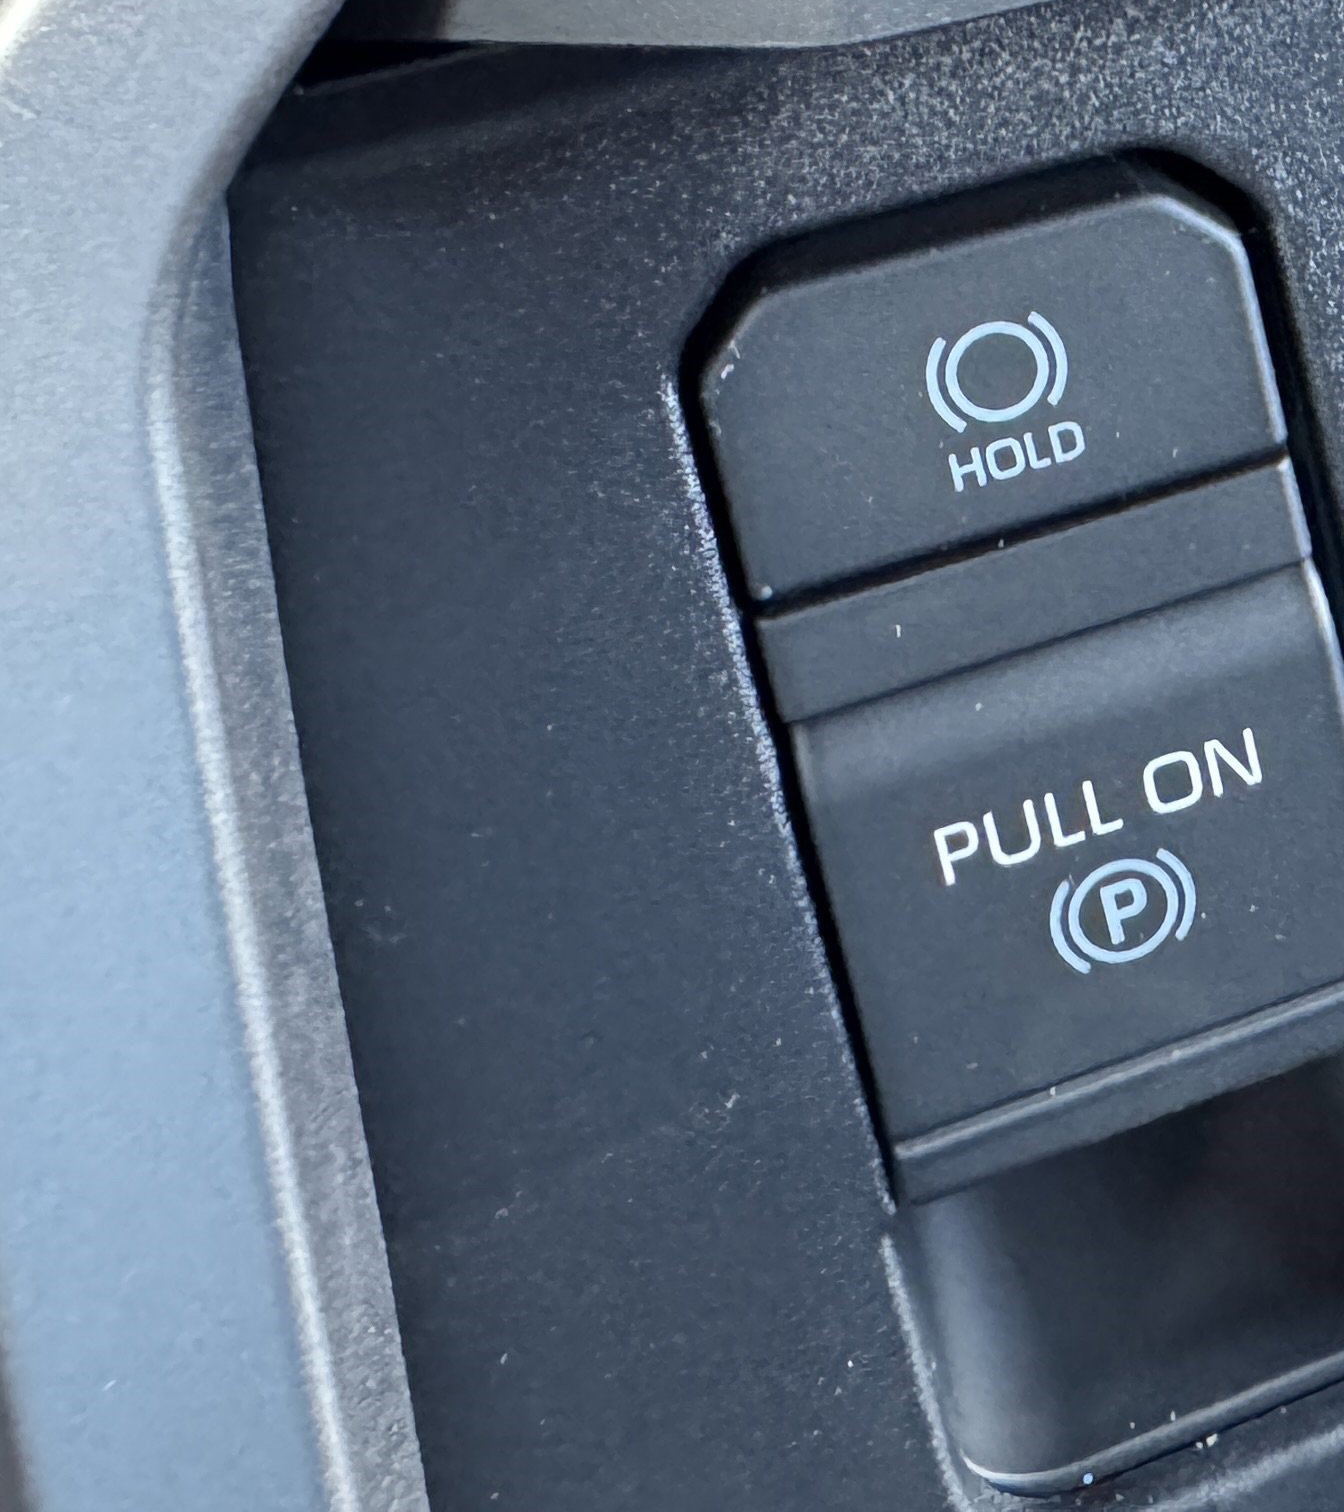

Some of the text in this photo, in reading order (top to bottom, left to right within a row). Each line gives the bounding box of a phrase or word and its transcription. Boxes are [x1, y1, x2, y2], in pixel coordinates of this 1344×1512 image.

[948, 420, 1086, 492] HOLD
[933, 727, 1264, 886] PULL ON
